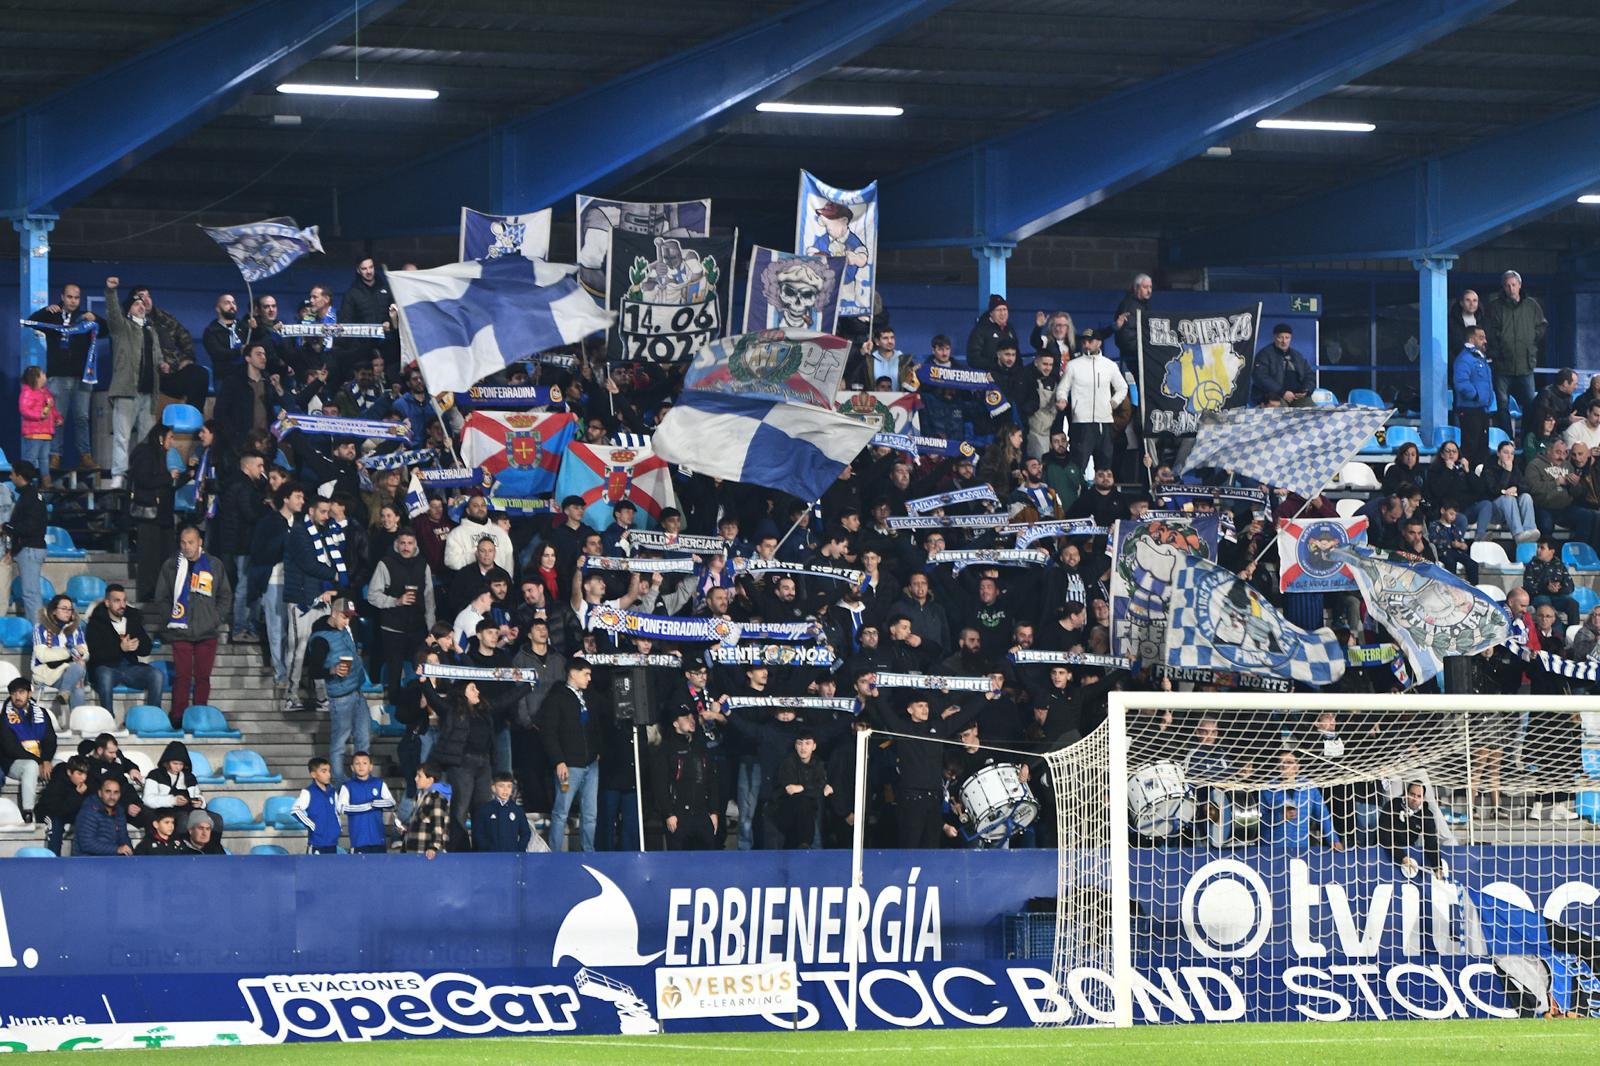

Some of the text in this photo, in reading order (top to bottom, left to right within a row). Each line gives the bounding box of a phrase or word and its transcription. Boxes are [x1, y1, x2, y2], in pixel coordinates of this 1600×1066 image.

[281, 324, 385, 336] FRENTE NORTE
[1149, 313, 1253, 347] EL BIERZO
[1150, 409, 1200, 437] BLAN
[931, 551, 1047, 562] FRENTE NORTE
[710, 645, 760, 661] FRENTE
[1018, 651, 1130, 668] FRENTE NORTE
[880, 675, 991, 691] FRENTE NORTE
[1156, 666, 1290, 691] FRENTE NORTE
[731, 697, 848, 709] FRENTE NORTE
[665, 866, 943, 966] ERBIENERGÍA
[273, 977, 421, 993] ELEVACIONES
[686, 971, 792, 996] VERSUS
[239, 973, 581, 1043] JopeCar
[700, 994, 783, 1009] E-LEARNING
[62, 1014, 86, 1026] de
